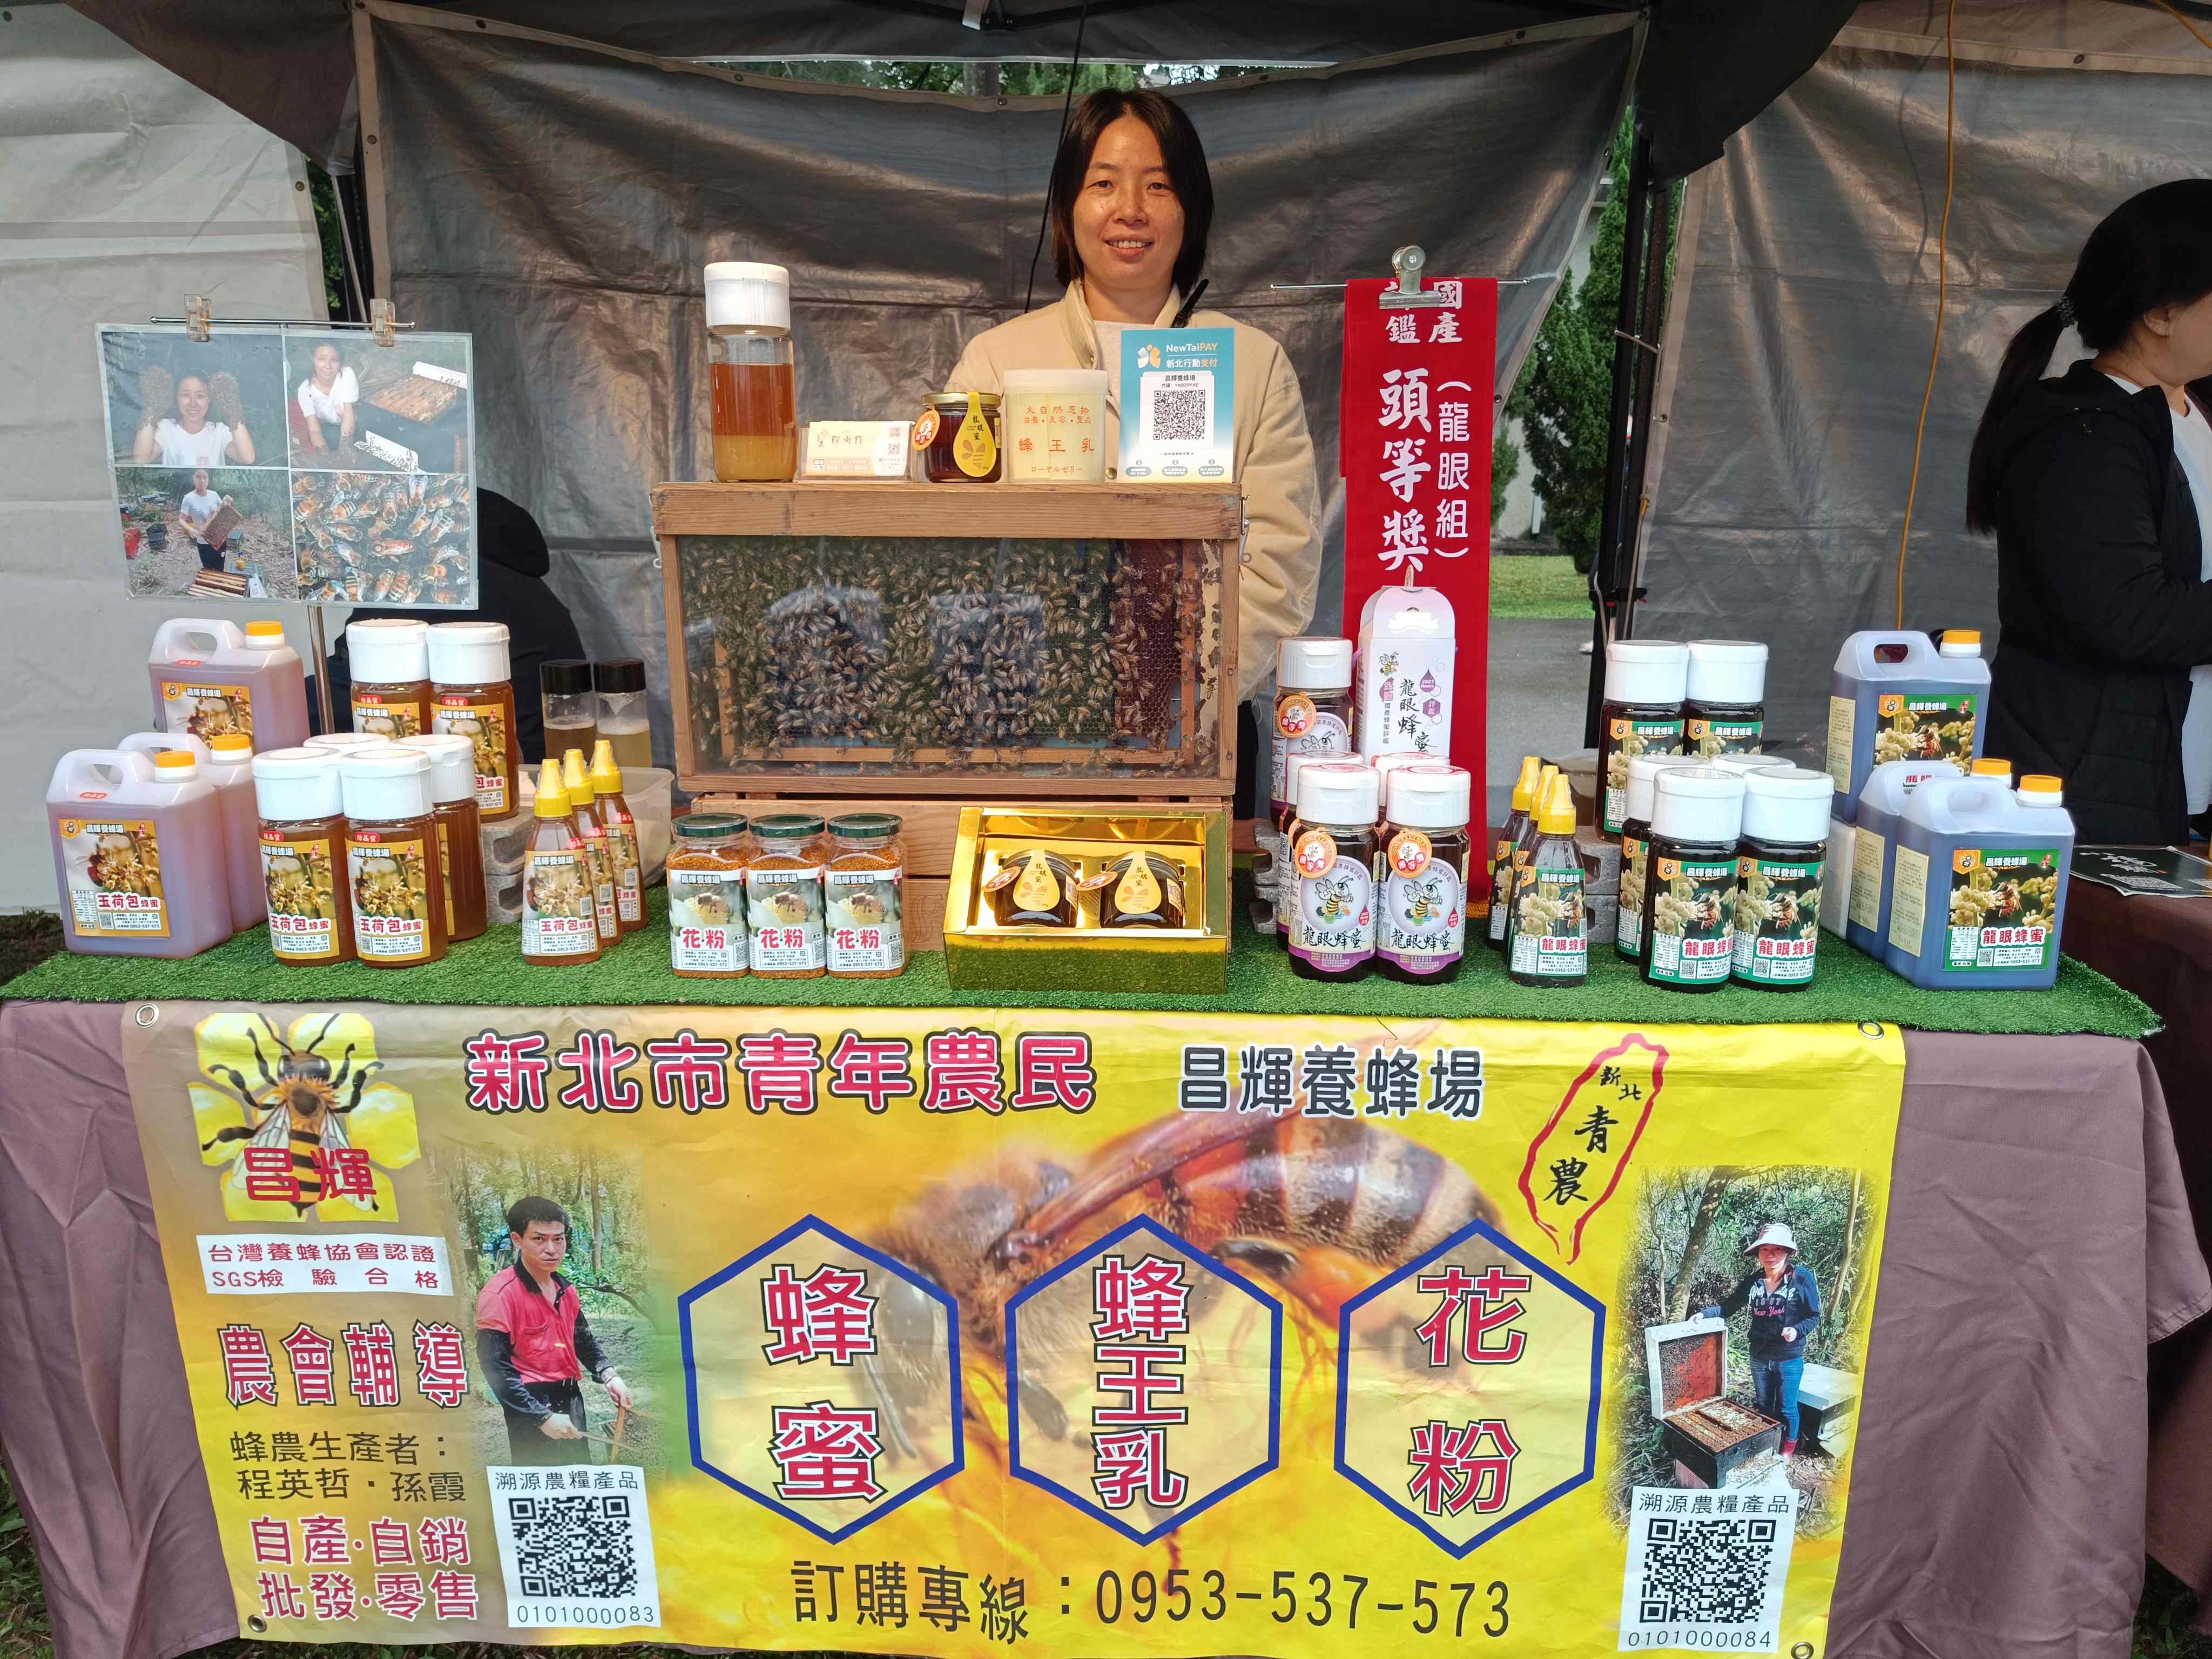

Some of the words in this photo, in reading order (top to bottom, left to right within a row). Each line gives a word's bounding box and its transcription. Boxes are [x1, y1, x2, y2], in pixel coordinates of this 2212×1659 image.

[1166, 342, 1218, 353] NewTaiPAY
[1166, 358, 1218, 368] 新北行動支付
[1026, 406, 1089, 415] 大自然恩物
[1019, 437, 1095, 453] 蜂王乳
[1378, 367, 1433, 572] 頭等獎
[1434, 381, 1472, 558] (龍眼組)
[1398, 678, 1438, 753] 龍眼蜂蜜
[97, 894, 159, 908] 玉荷包蜂蜜
[271, 916, 329, 932] 玉荷包蜂蜜
[360, 918, 422, 933] 玉荷包蜂蜜
[683, 928, 725, 949] 花粉
[760, 928, 803, 949] 花粉
[836, 928, 880, 950] 花粉
[1303, 925, 1366, 950] 龍眼蜂蜜
[1391, 928, 1456, 953] 龍眼蜂蜜
[1982, 928, 2044, 945] 龍眼蜂蜜
[1758, 940, 1815, 956] 龍眼蜂蜜
[464, 1030, 1096, 1115] 新北市青年農民
[1181, 1043, 1483, 1121] 昌輝養蜂場
[1599, 1065, 1642, 1102] 新北
[1543, 1105, 1620, 1206] 青農
[243, 1146, 377, 1202] 昌輝
[207, 1242, 436, 1264] 台灣養蜂協會認證
[216, 1318, 470, 1411] 農會輔導
[760, 1262, 887, 1505] 蜂蜜
[1090, 1252, 1194, 1511] 蜂王乳
[1407, 1264, 1533, 1518] 花粉
[230, 1431, 446, 1466] 蜂農生產者:
[494, 1470, 639, 1493] 溯源農糧產品
[1638, 1492, 1790, 1514] 溯源農糧產品
[517, 1604, 655, 1626] 0101000083
[1628, 1629, 1771, 1649] 0101000084
